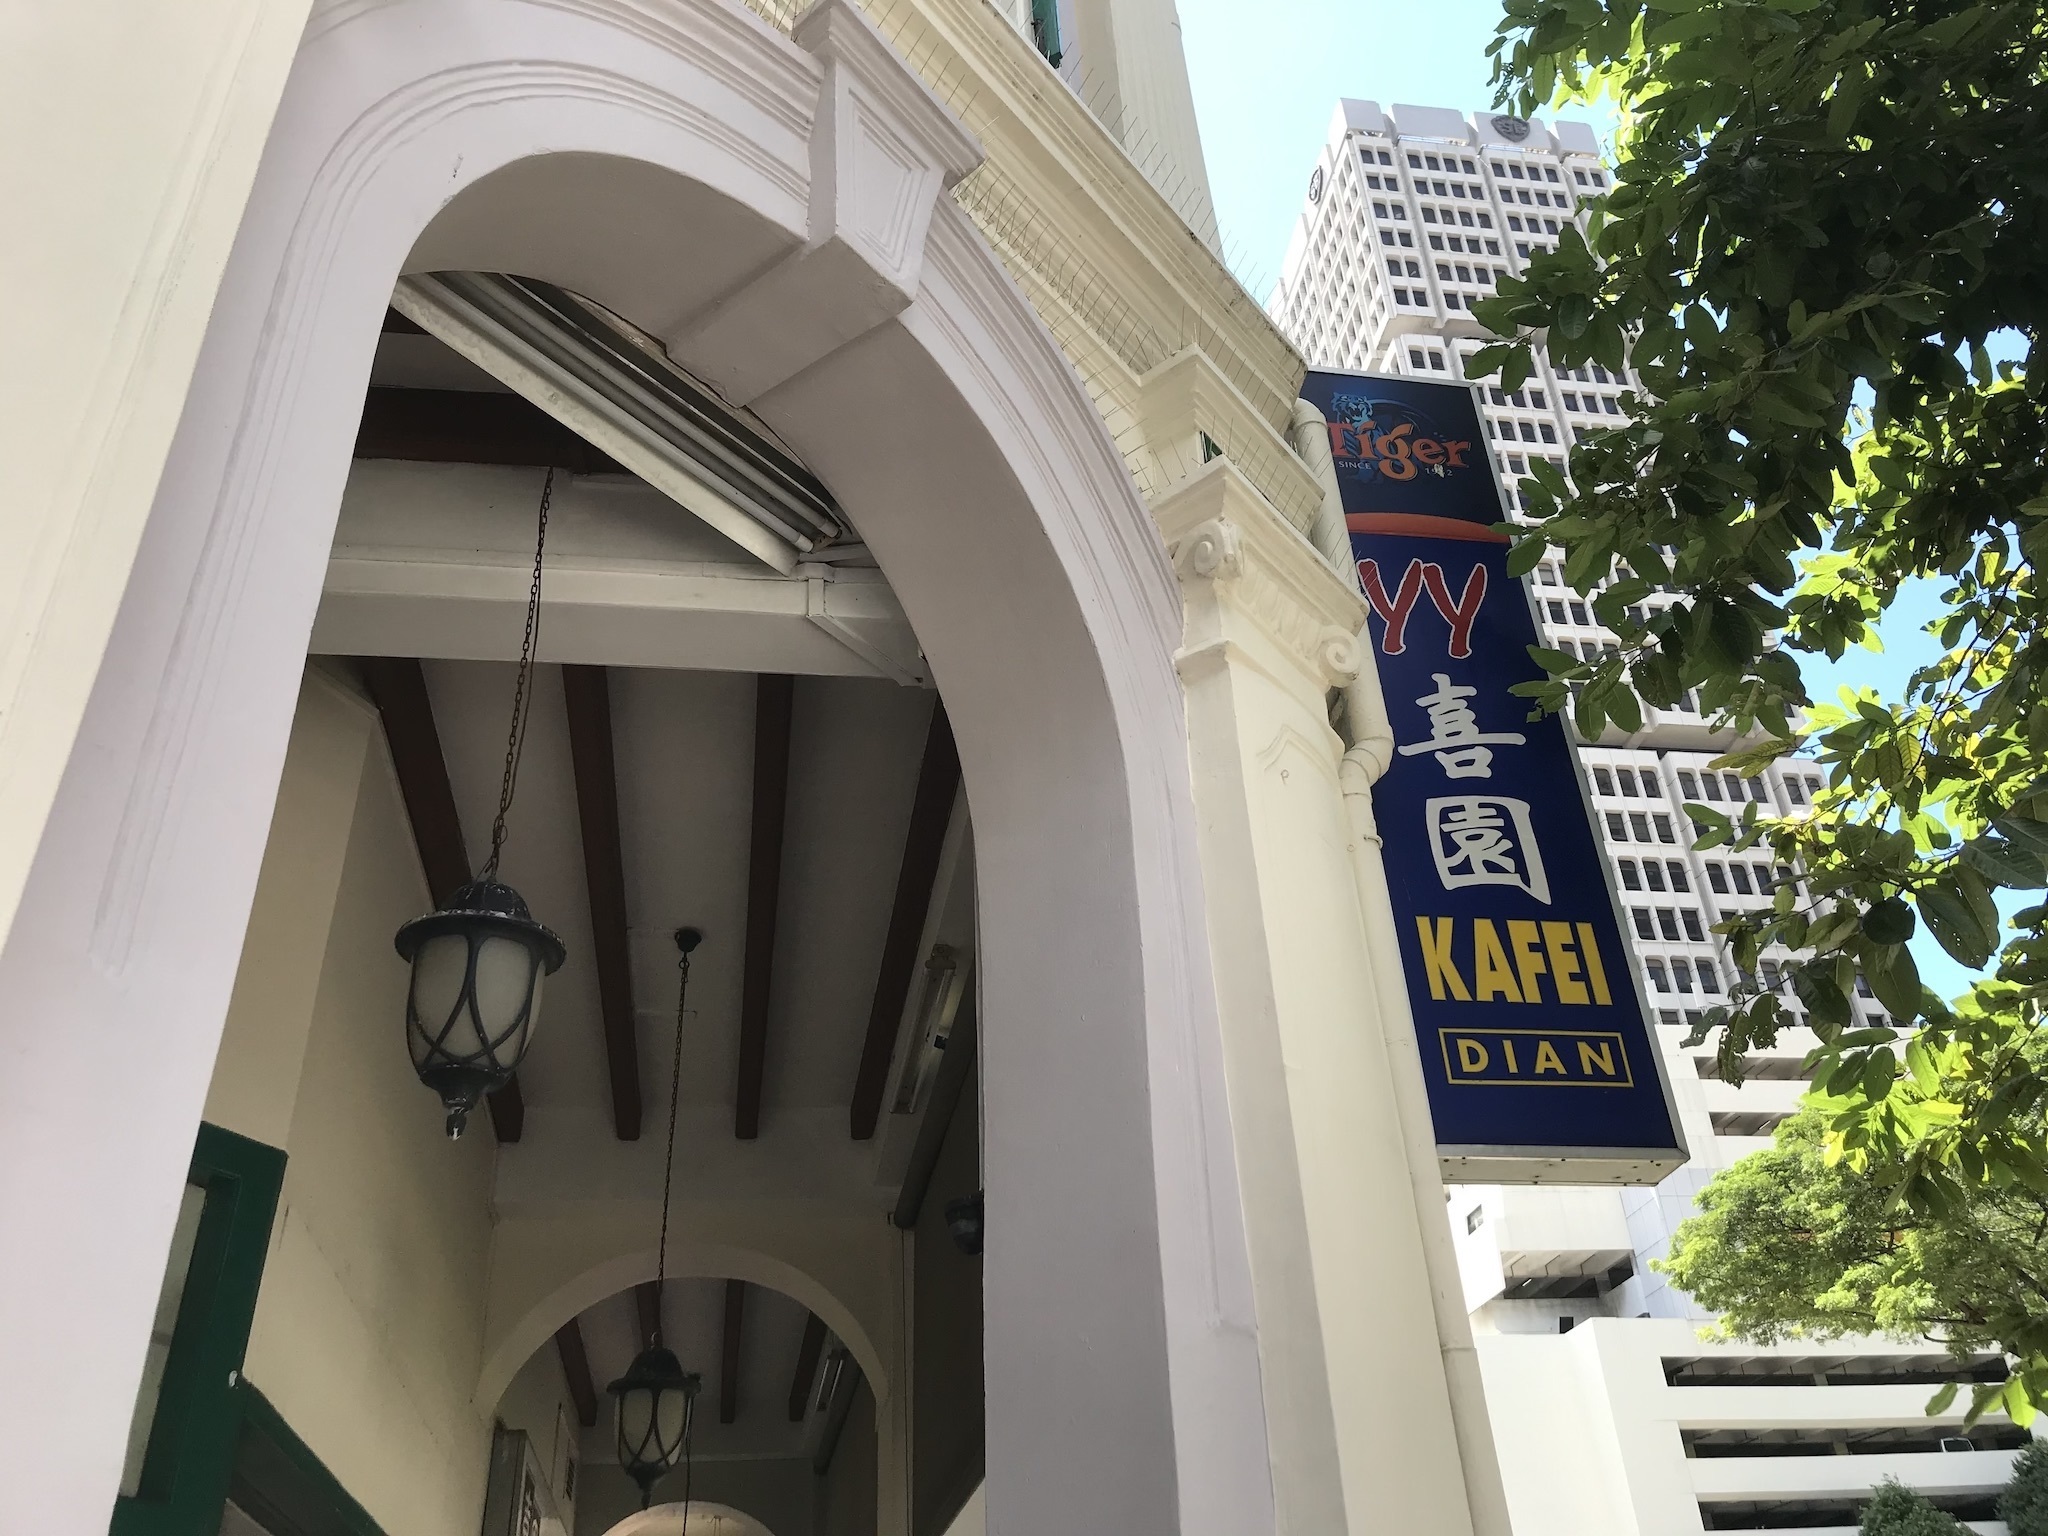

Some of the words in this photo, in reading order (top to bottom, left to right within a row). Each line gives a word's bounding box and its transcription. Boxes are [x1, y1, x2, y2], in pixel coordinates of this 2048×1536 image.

[1328, 420, 1471, 481] Tiger
[1339, 461, 1372, 470] SINCE
[1357, 558, 1487, 658] YY
[1398, 673, 1551, 905] 喜園
[1416, 916, 1613, 1006] KAFEI
[1457, 1038, 1616, 1076] DIAN
